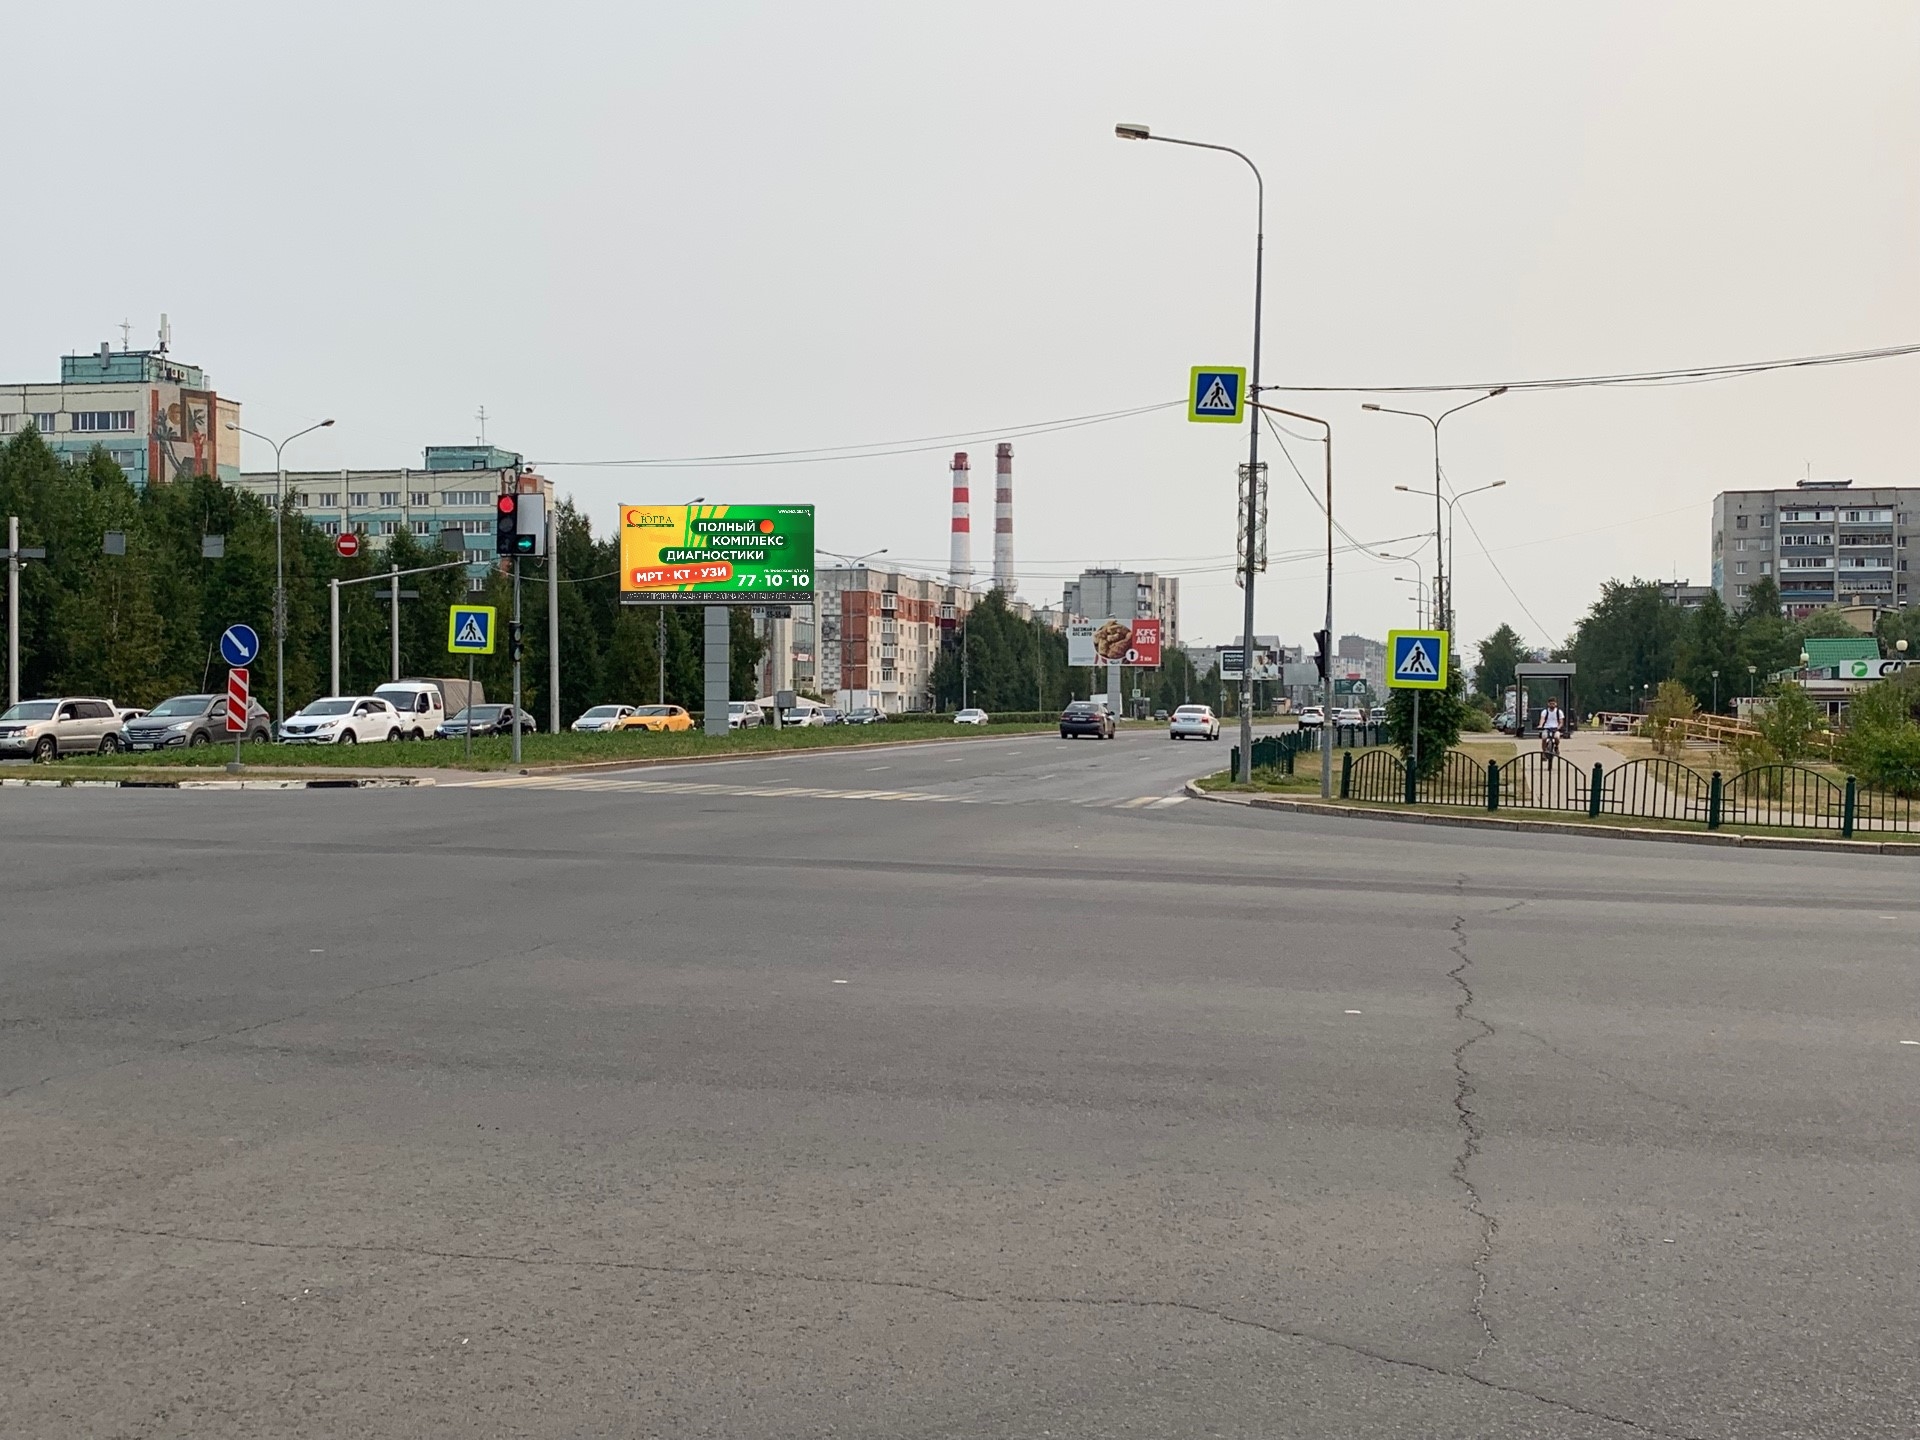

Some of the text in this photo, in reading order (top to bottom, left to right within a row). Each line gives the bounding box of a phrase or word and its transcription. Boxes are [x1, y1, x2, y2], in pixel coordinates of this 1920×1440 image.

[640, 513, 673, 524] ЮГРА
[698, 520, 756, 532] ПОЛНЫЙ
[712, 535, 784, 546] КОМПЛЕКС
[666, 550, 764, 562] ДИАГНОСТИКИ
[636, 566, 727, 582] МРТ КТ УЗИ
[1135, 628, 1157, 636] KFC
[1135, 636, 1156, 644] АВТО
